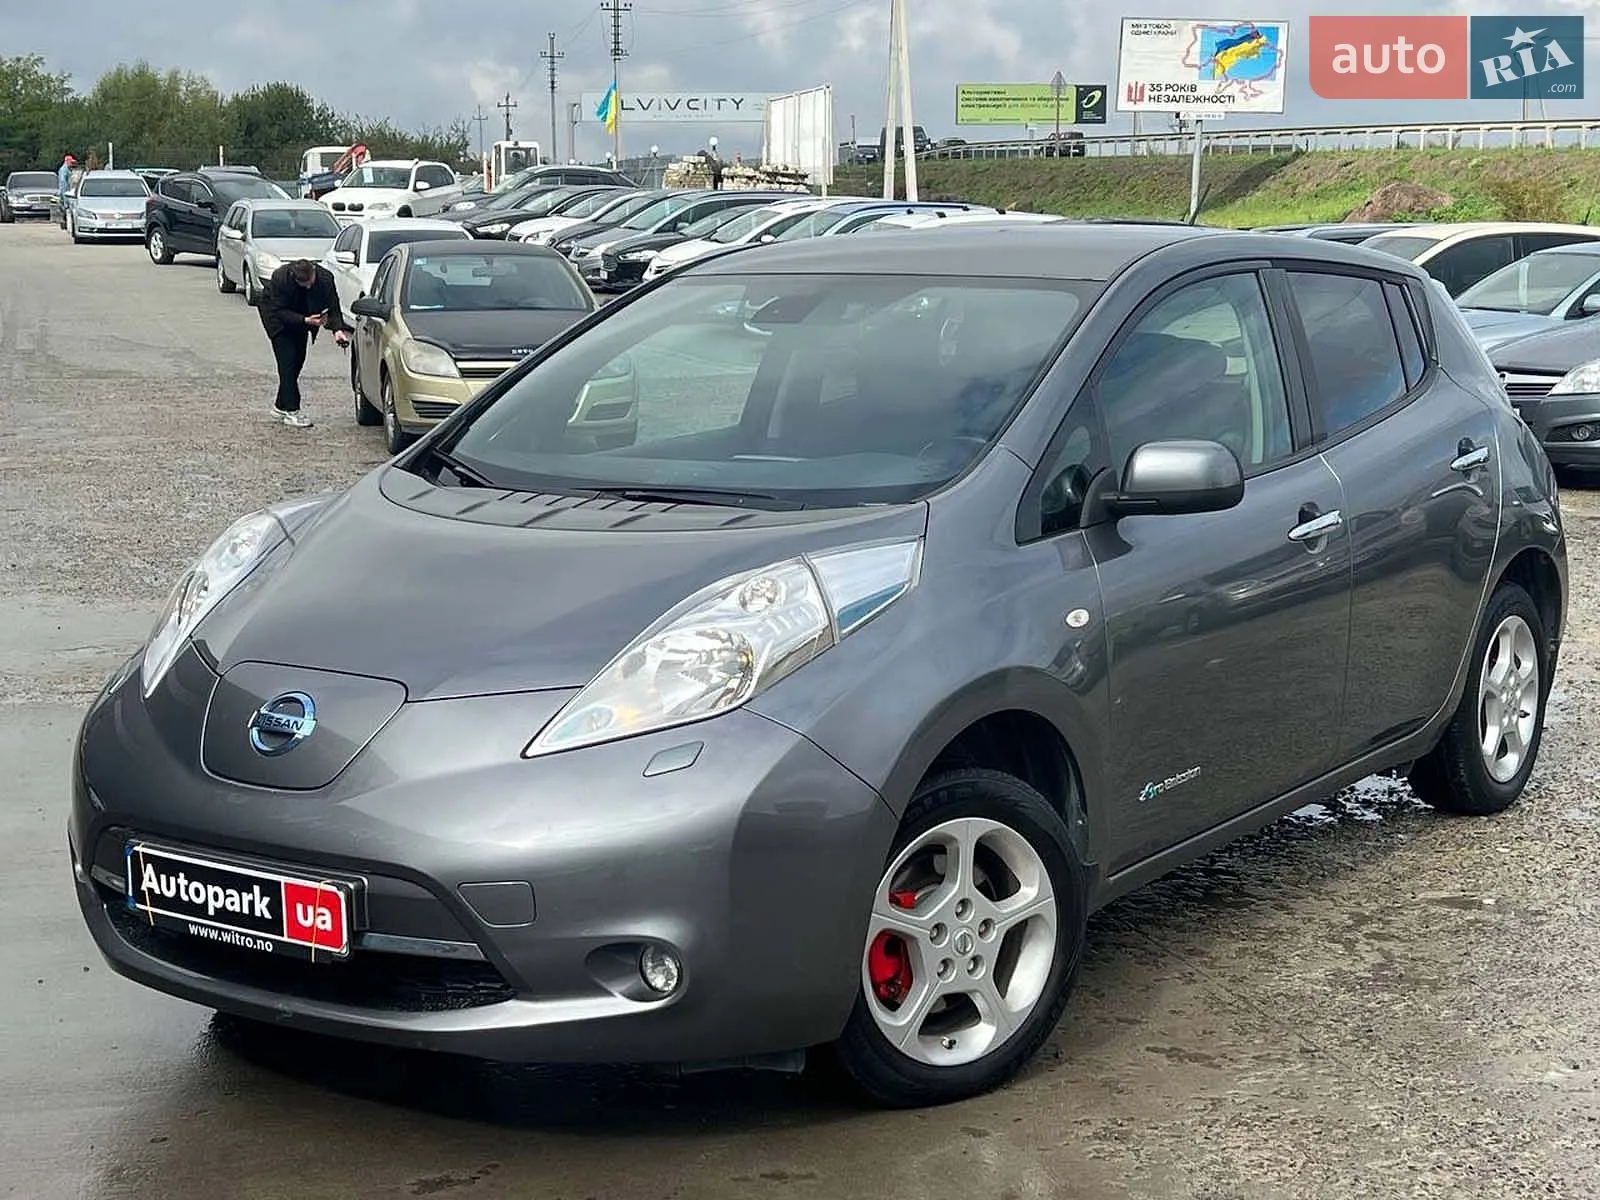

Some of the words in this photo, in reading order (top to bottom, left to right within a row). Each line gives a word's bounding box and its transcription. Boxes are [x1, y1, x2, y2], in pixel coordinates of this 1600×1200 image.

[1148, 83, 1163, 93] 35
[1164, 83, 1197, 93] РОКІВ
[1148, 94, 1236, 105] НЕЗАЛЕЖНОСТІ
[254, 713, 305, 731] NISSAN
[141, 863, 273, 920] Autopark
[295, 901, 333, 932] ua
[188, 923, 274, 952] www.witro.no
